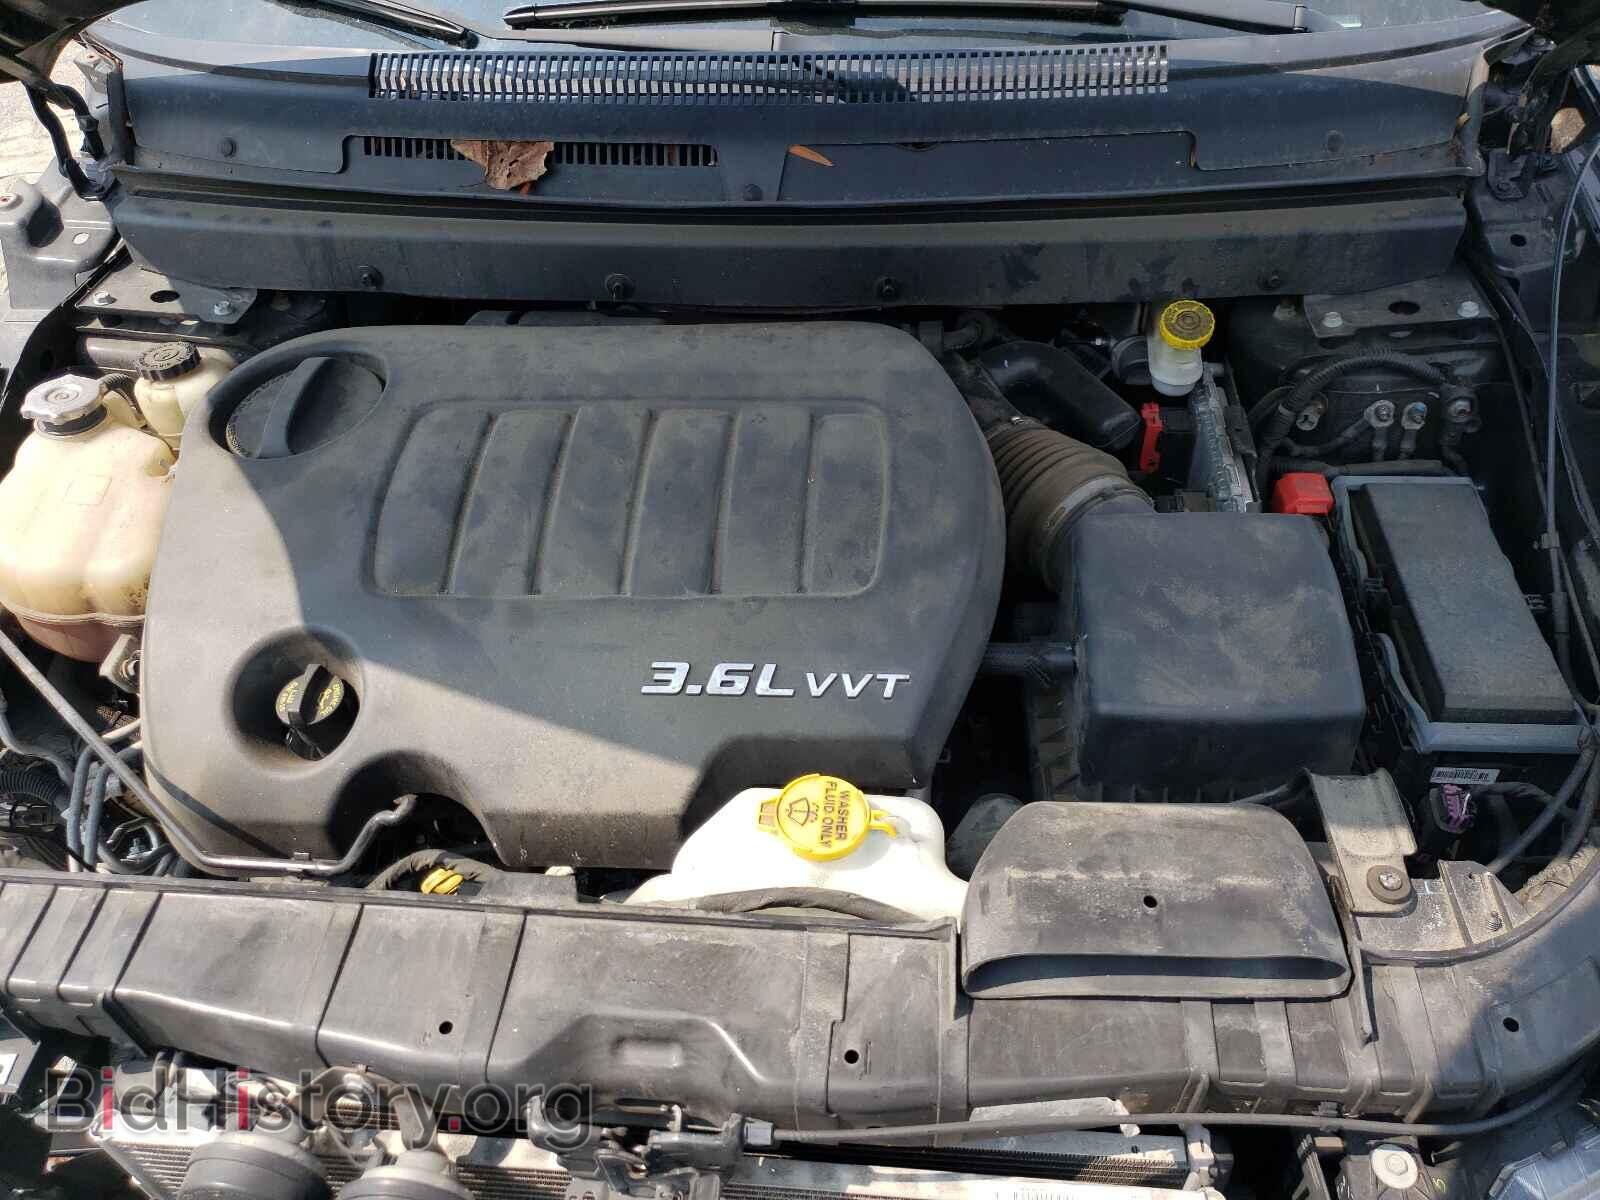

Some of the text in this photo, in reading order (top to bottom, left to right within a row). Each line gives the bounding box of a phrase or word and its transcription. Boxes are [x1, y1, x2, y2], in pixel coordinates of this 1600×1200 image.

[640, 661, 911, 699] 3.6L VVT
[819, 780, 838, 849] FLUID ONLY
[835, 790, 851, 841] WASHER
